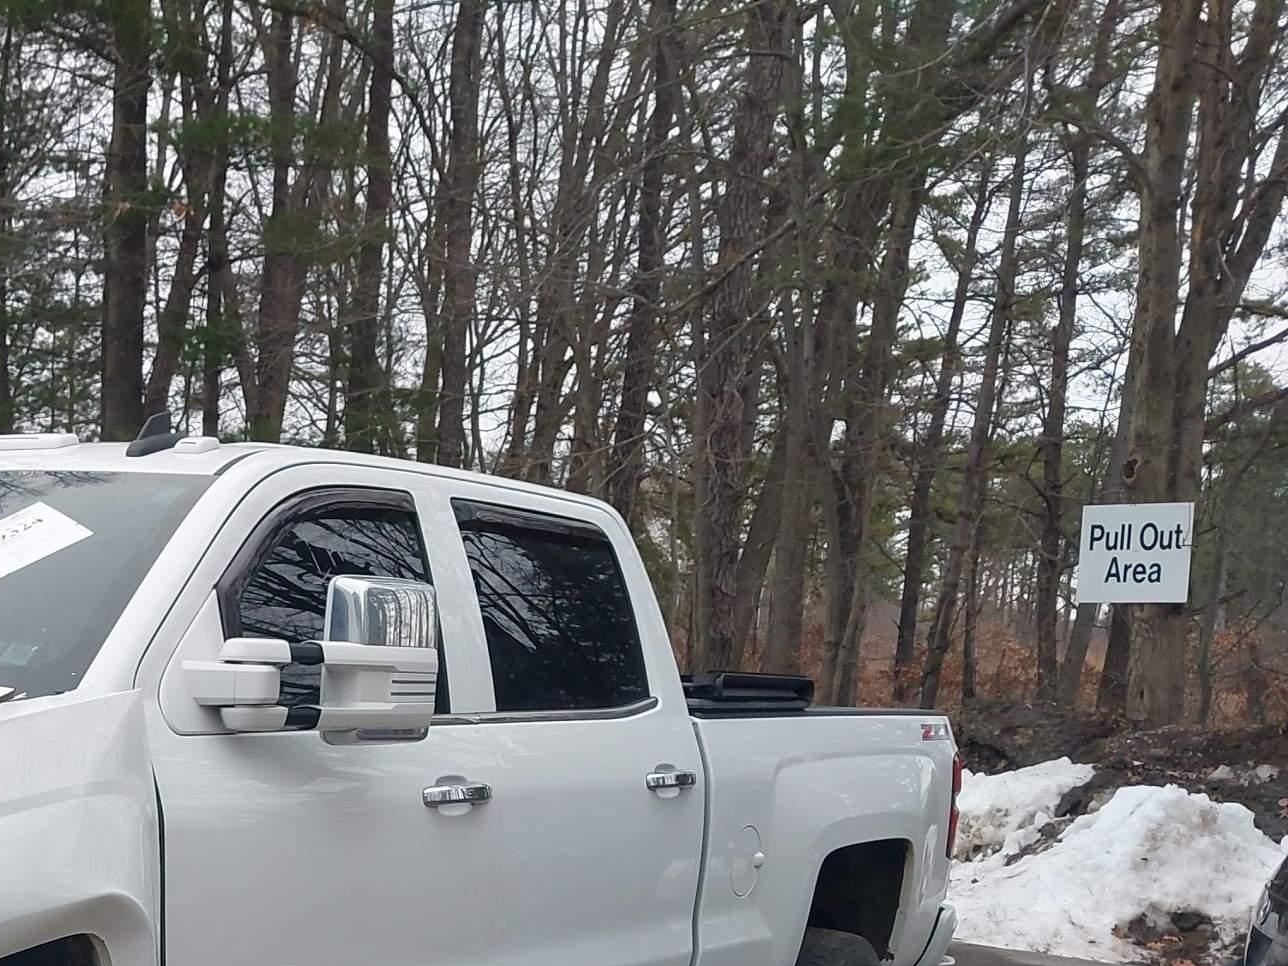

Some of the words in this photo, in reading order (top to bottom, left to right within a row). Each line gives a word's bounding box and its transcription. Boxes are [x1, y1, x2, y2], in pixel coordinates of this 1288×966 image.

[1089, 523, 1132, 551] Pull
[1139, 522, 1183, 551] Out
[1104, 556, 1162, 584] Area
